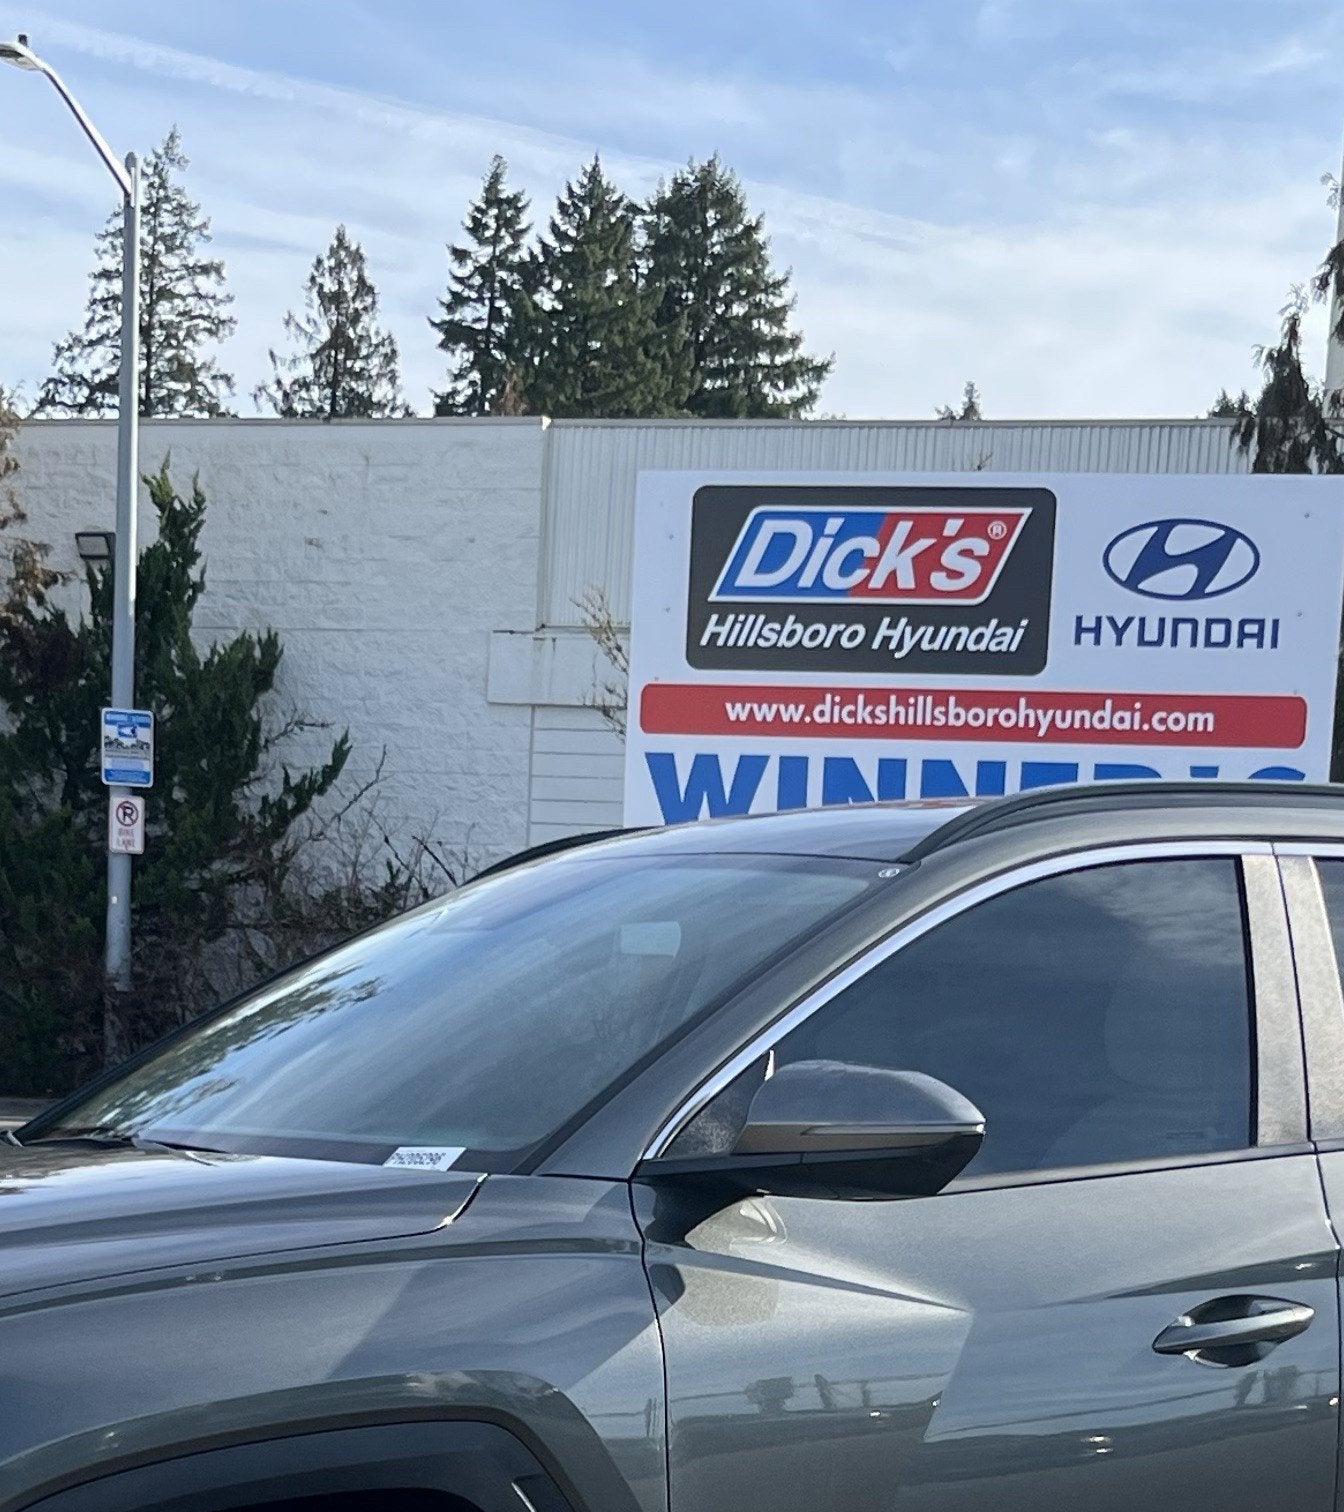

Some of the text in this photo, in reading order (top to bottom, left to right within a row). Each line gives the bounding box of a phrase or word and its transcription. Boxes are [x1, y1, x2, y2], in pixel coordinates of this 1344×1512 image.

[733, 516, 991, 592] Dick's
[699, 613, 1030, 660] Hillsboro Hyundai
[1073, 614, 1282, 650] HYUNDAI
[724, 693, 1216, 738] www.dickshillsborohyundai.com
